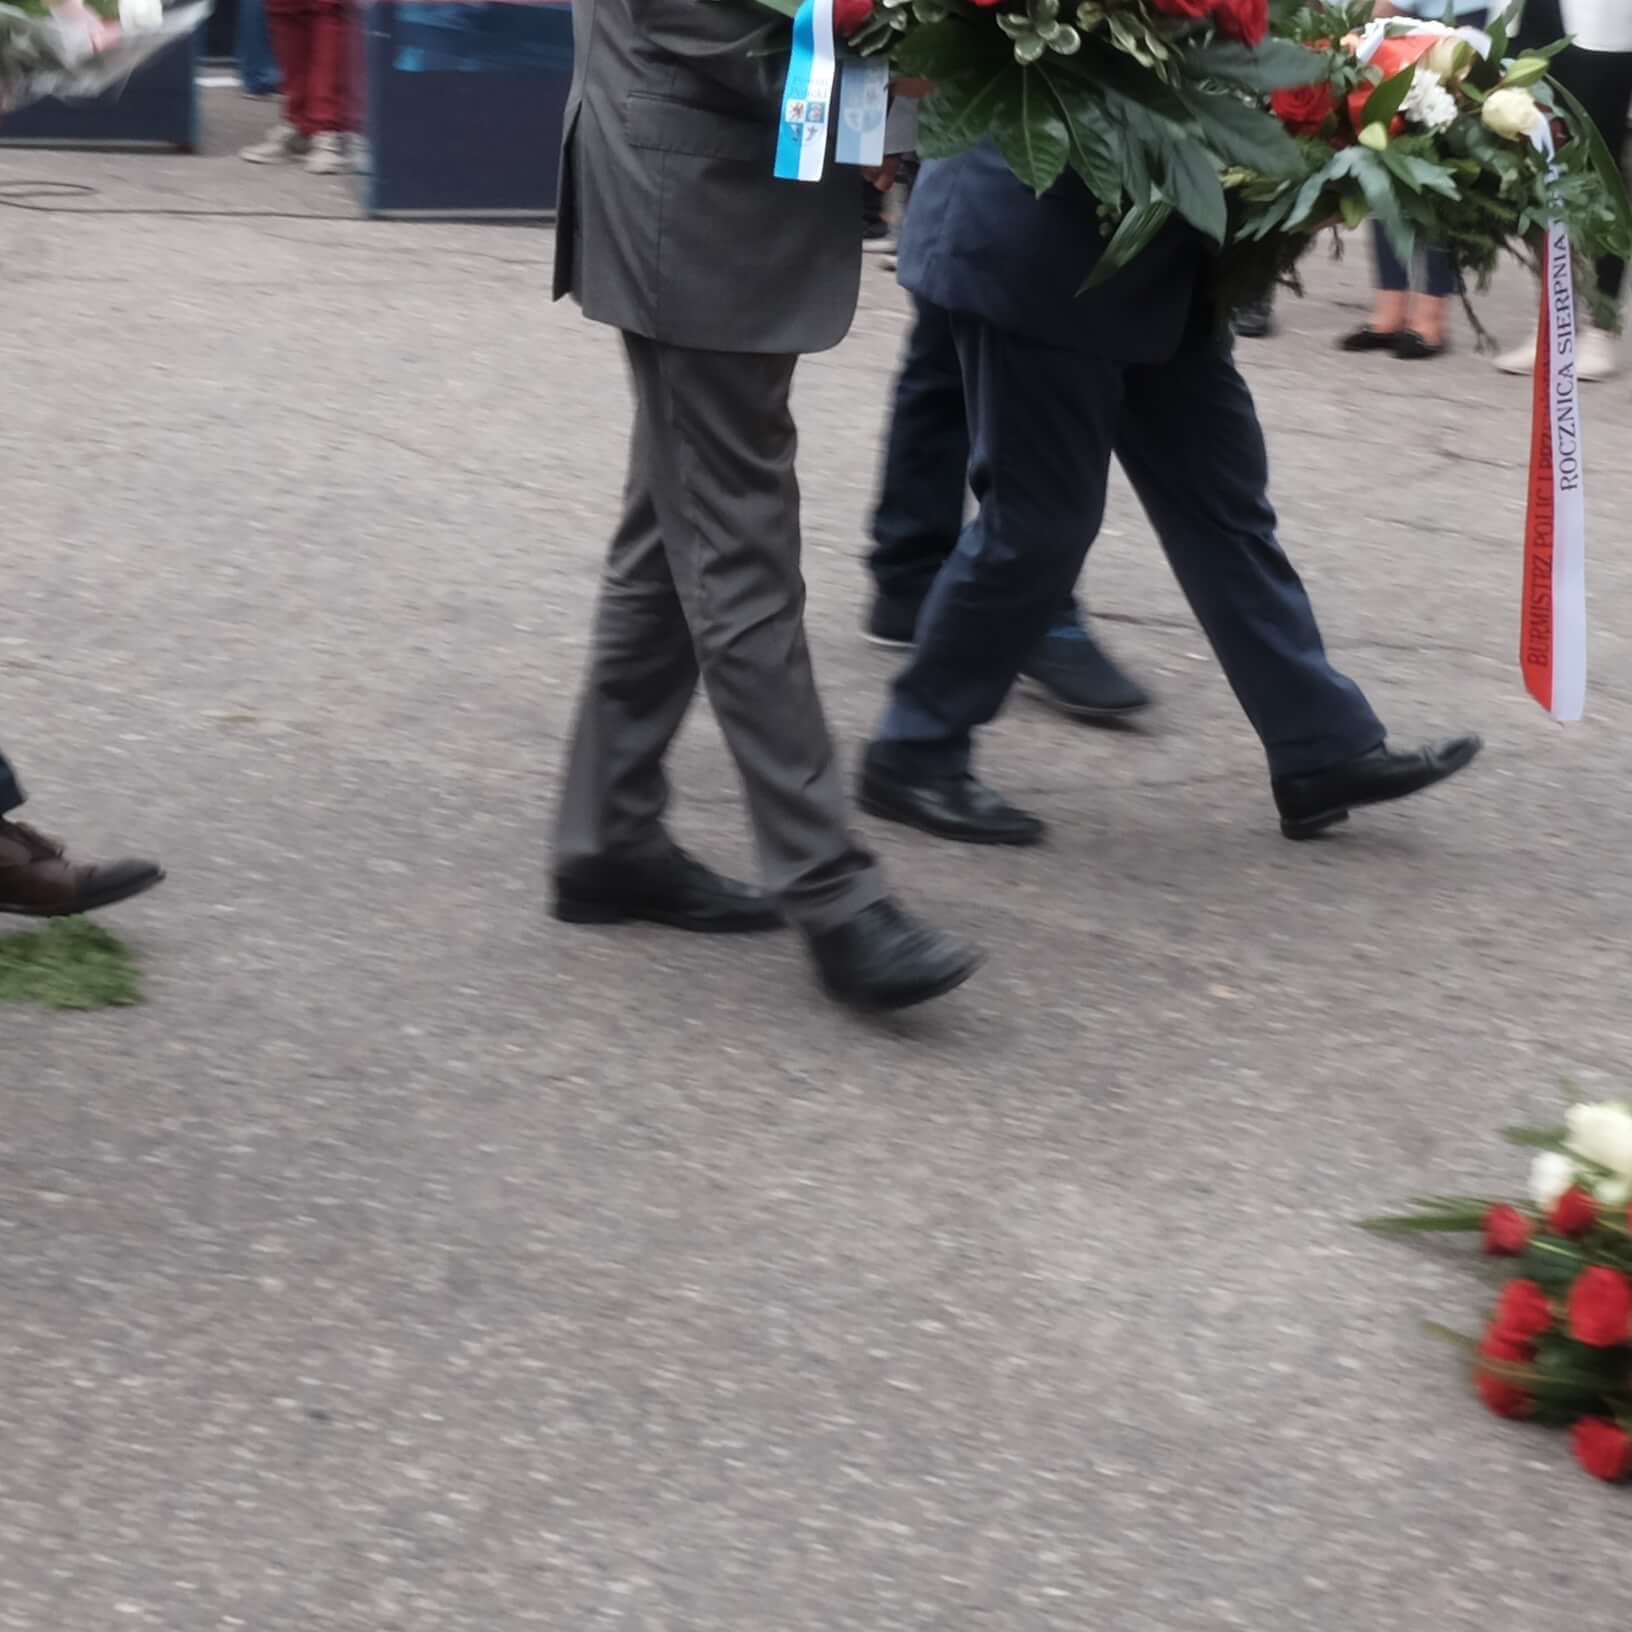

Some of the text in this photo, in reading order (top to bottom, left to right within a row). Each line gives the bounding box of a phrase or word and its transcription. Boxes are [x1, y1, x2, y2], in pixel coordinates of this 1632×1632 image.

[1553, 234, 1574, 355] SIERPNIA
[1556, 361, 1579, 491] ROCZNICA
[1527, 553, 1553, 667] BURMISTRZ
